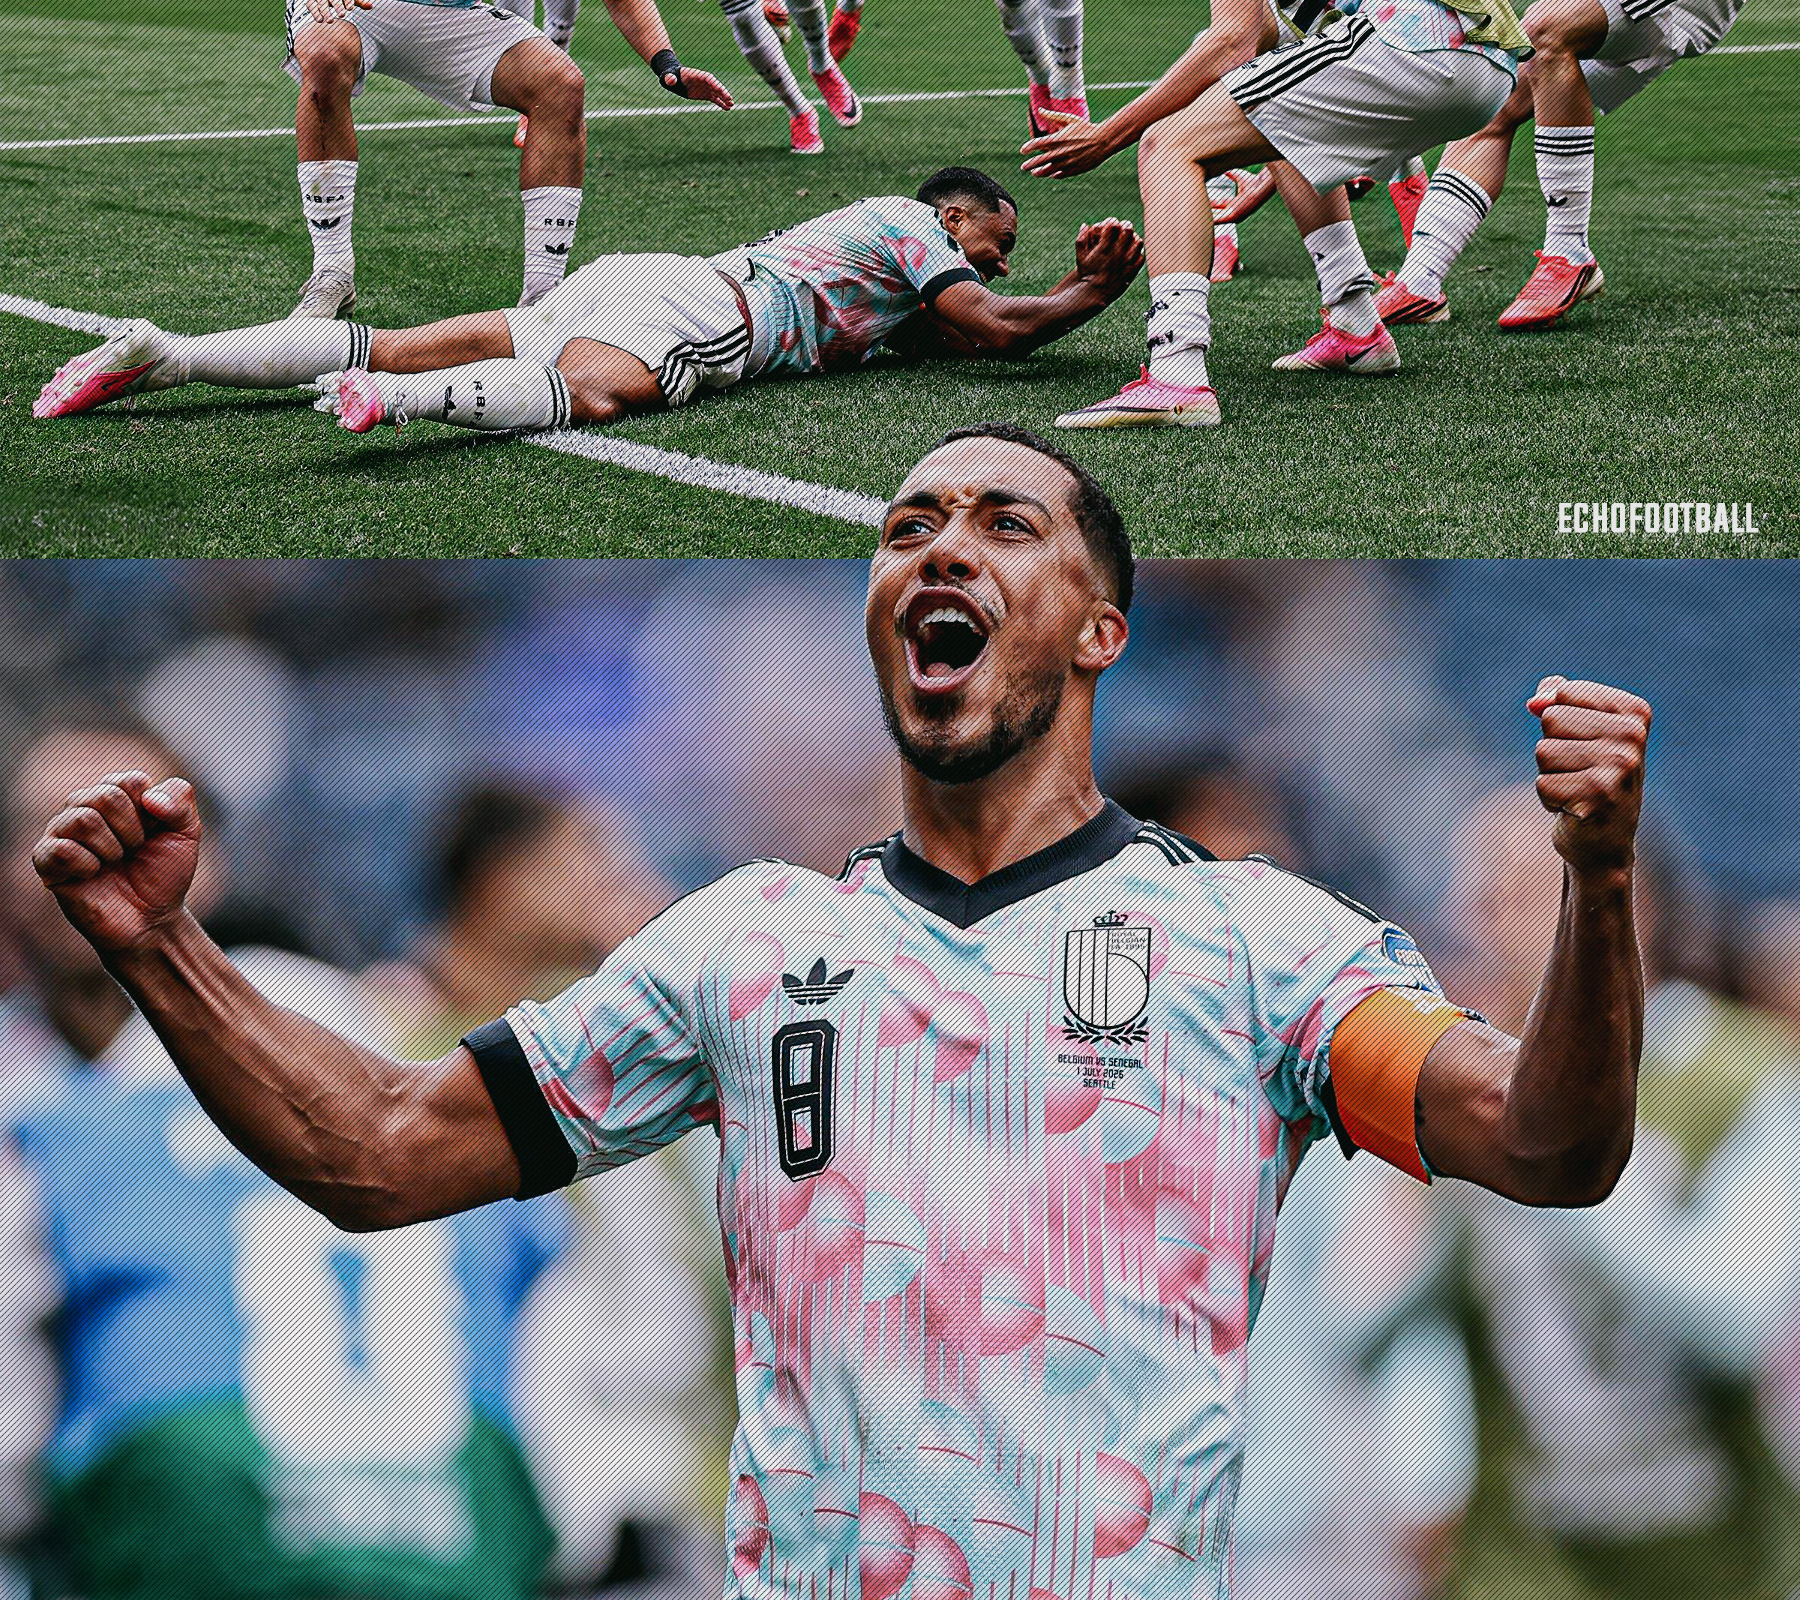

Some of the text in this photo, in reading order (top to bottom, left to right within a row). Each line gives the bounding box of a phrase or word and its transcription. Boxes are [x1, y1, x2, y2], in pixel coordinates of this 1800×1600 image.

[544, 217, 578, 228] RBF
[1057, 1053, 1144, 1069] BELGIUM VS SENEGAL
[1076, 1066, 1081, 1076] 1
[1082, 1067, 1101, 1077] JULY
[1082, 1078, 1116, 1090] SEATTLE
[772, 1018, 840, 1183] 8
